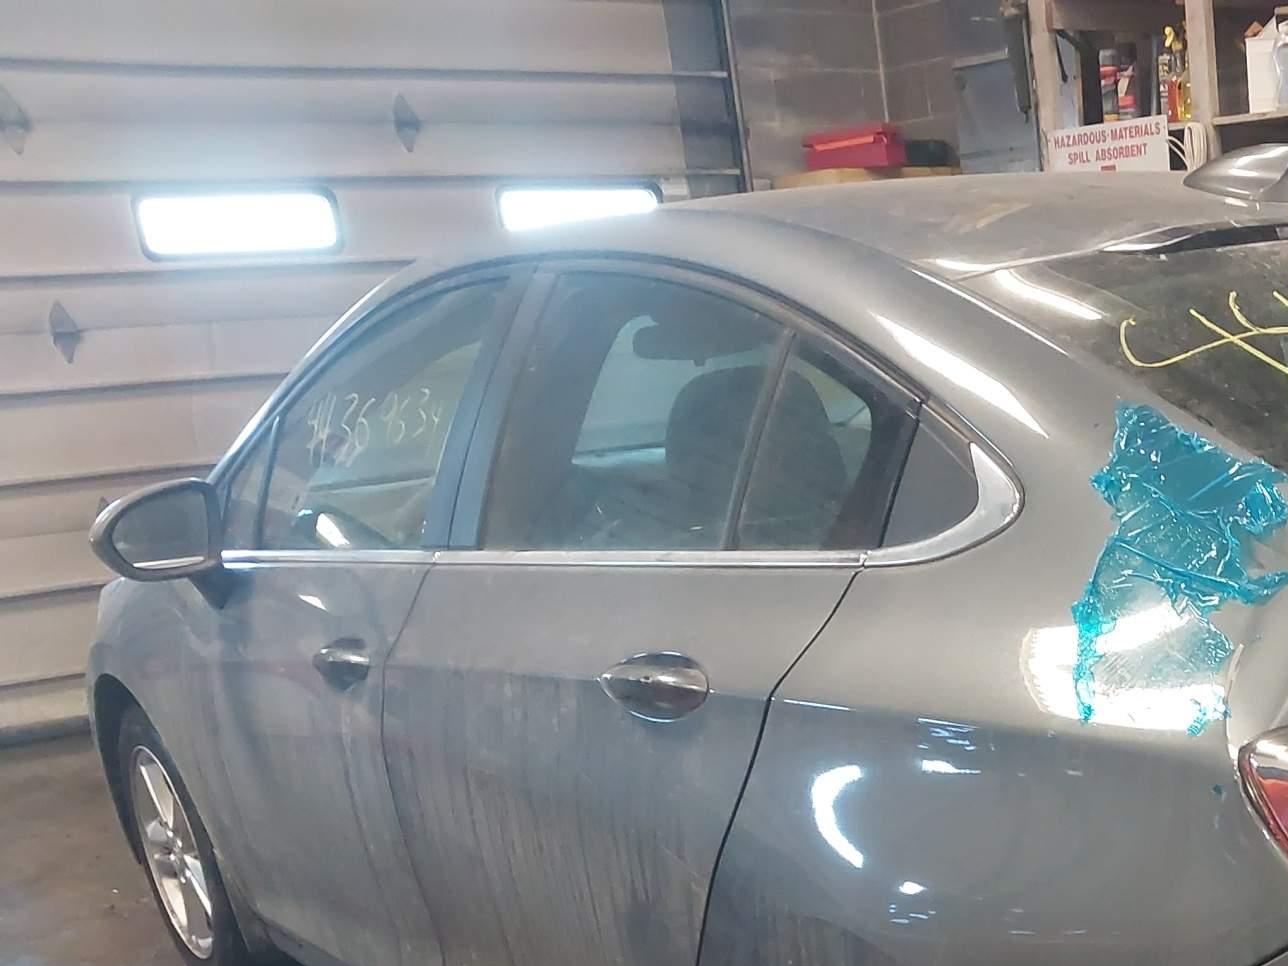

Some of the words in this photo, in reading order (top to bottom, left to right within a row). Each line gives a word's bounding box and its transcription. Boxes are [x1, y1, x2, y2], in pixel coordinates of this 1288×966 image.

[1054, 129, 1107, 149] HAZARDOUS
[1110, 122, 1161, 142] MATERIALS
[1067, 149, 1091, 165] SPILL
[1095, 143, 1148, 162] ABSORBENT
